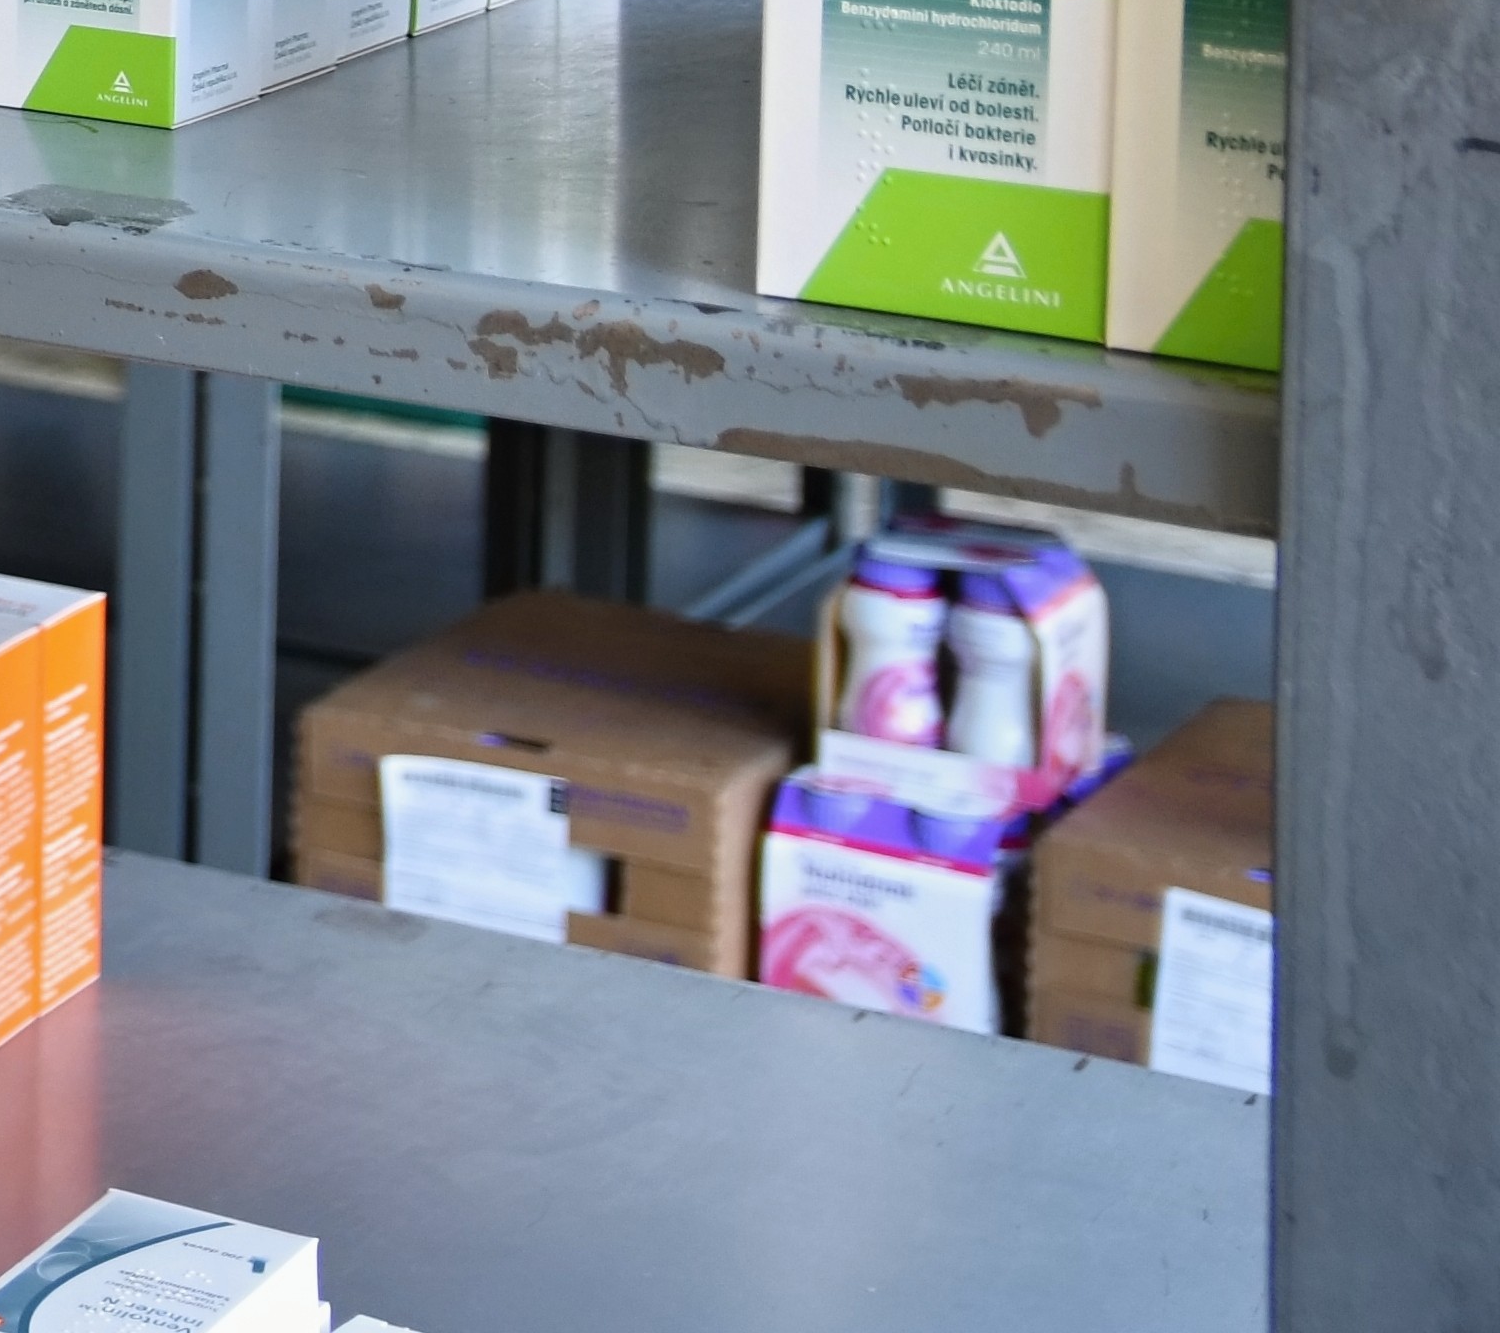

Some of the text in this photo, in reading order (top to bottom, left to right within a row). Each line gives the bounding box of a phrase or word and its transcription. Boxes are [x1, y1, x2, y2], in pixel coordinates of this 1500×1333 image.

[841, 1, 1041, 34] Benzydamini hydrochloridum
[978, 40, 1040, 60] 240 ml
[948, 73, 1039, 98] Léčí zánět.
[96, 93, 148, 107] ANGELINI
[845, 84, 1039, 122] Rychle uleví od bolesti.
[902, 115, 1036, 145] Potlačí bakterie
[960, 146, 1037, 171] kvasinky.
[939, 278, 1060, 308] ANGELINI
